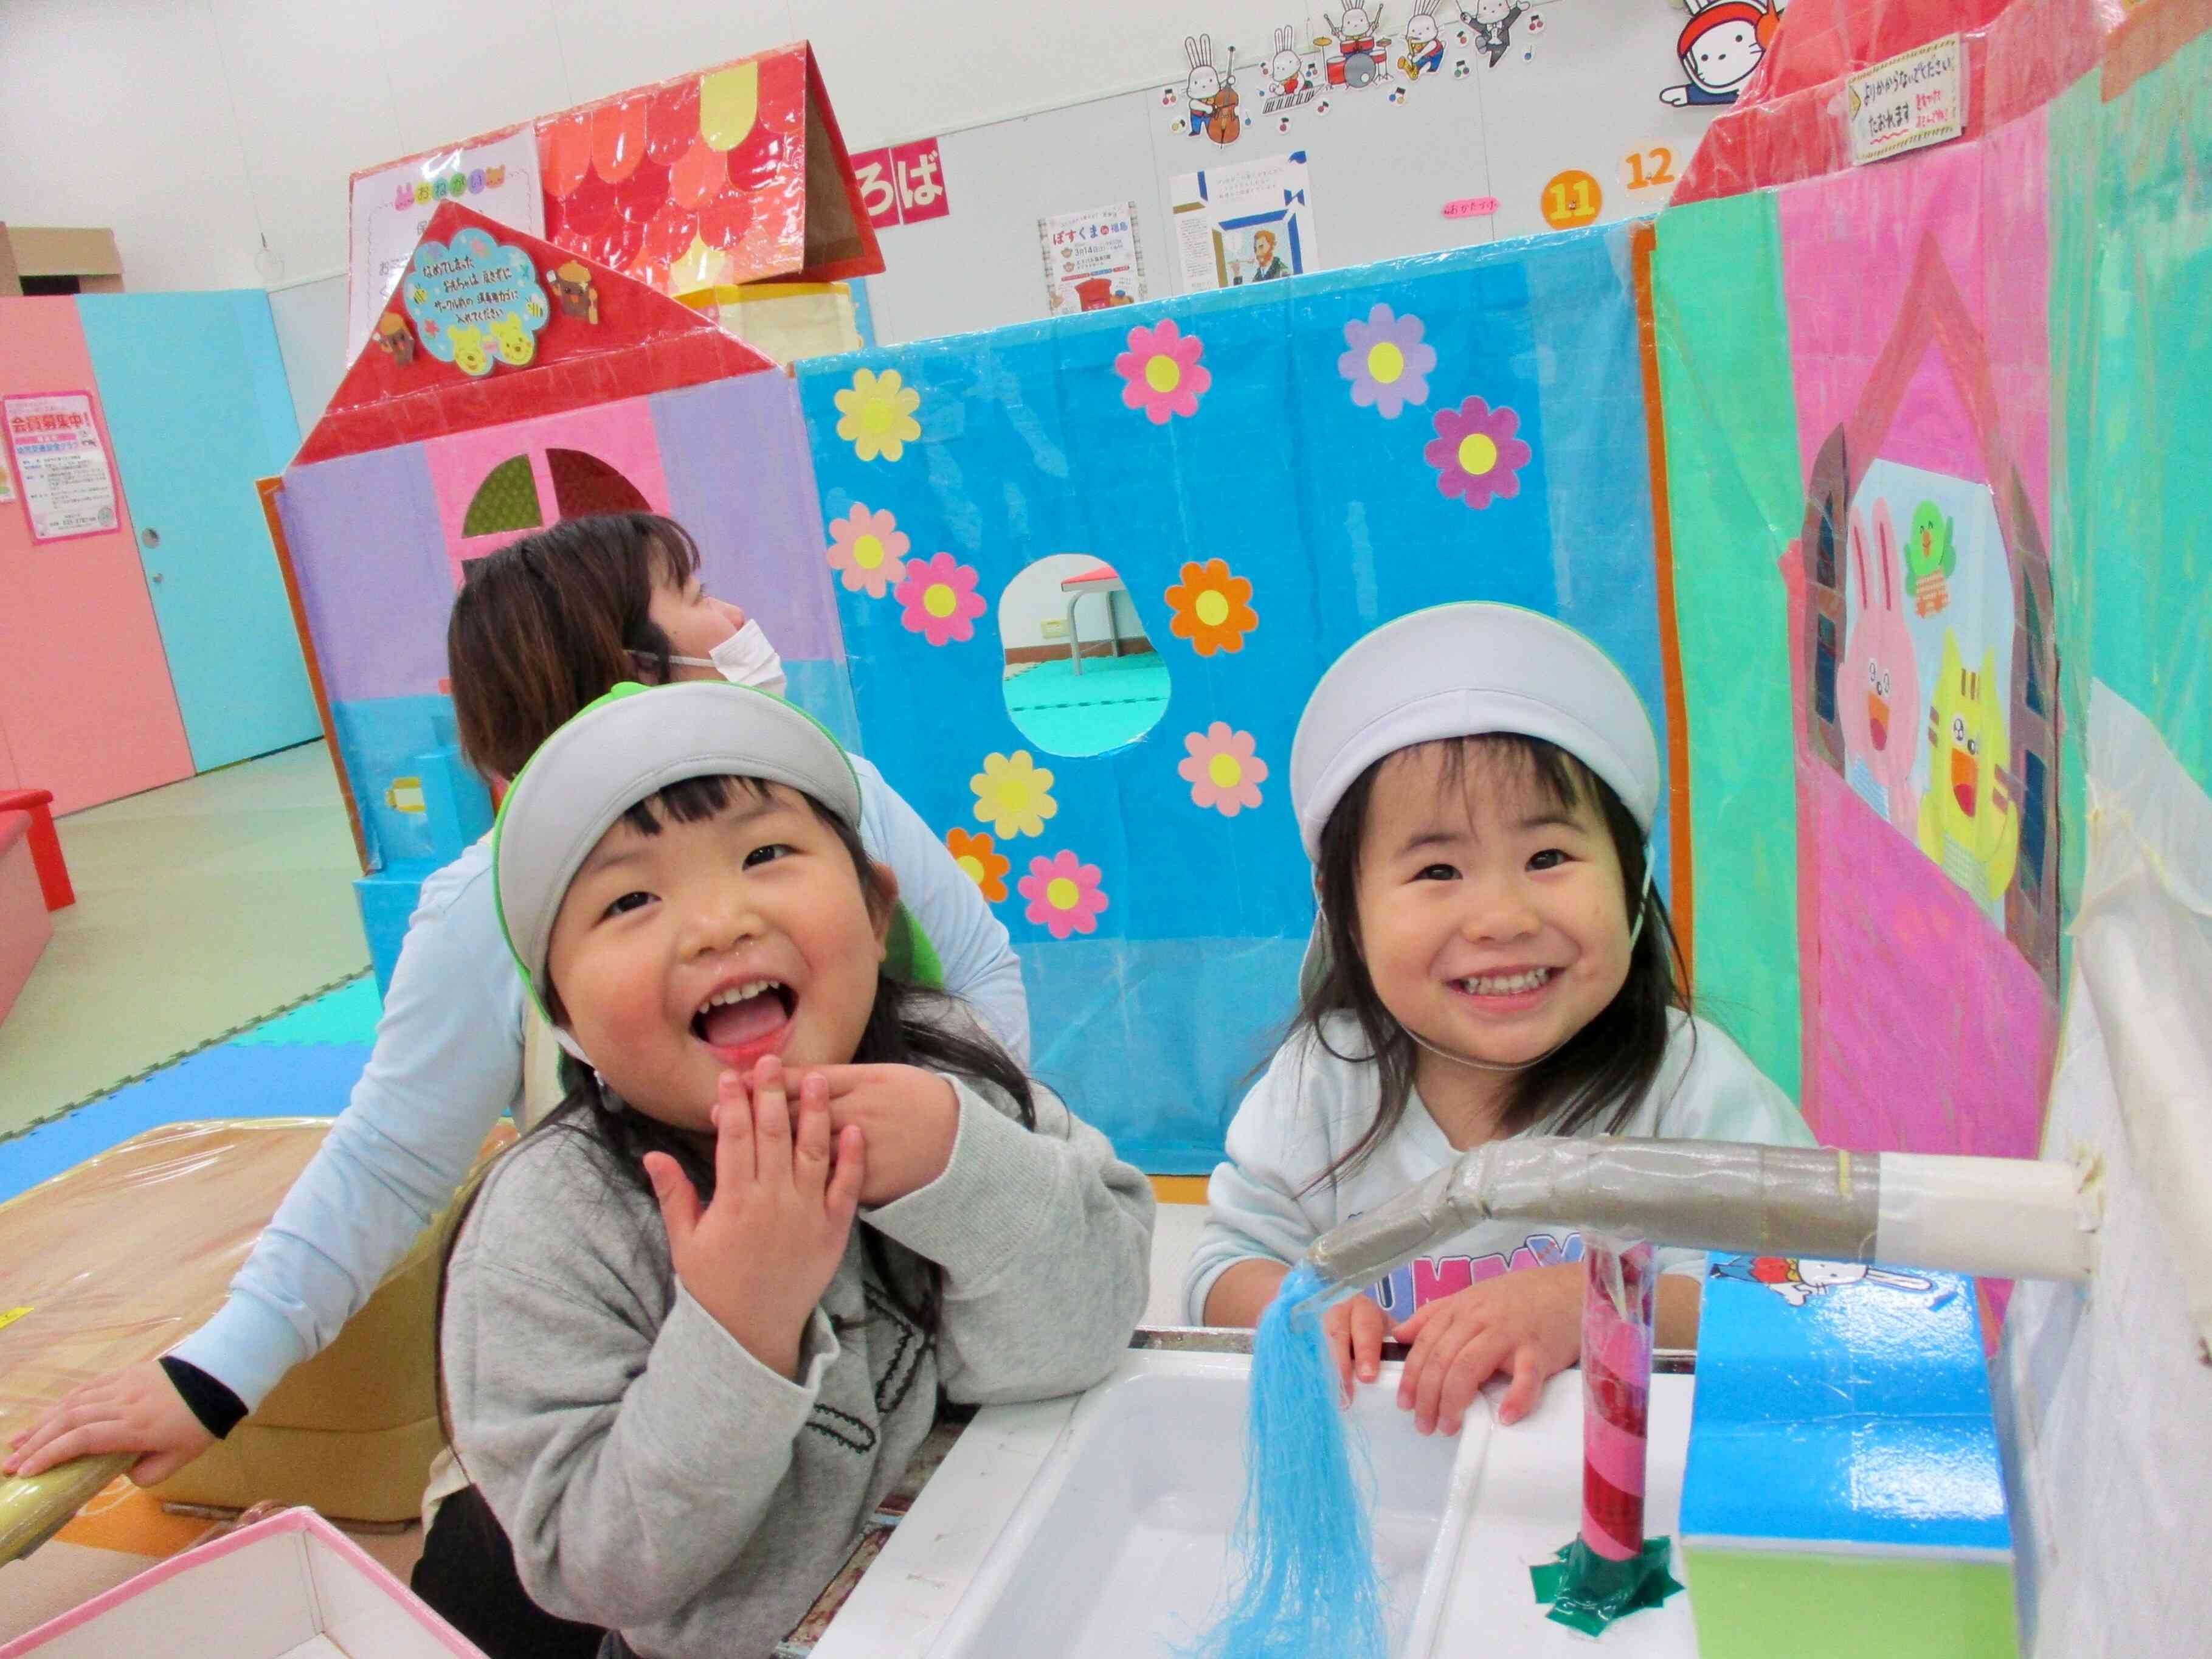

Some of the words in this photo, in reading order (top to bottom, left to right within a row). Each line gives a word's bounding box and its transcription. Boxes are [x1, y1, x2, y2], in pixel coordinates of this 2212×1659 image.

[418, 174, 483, 202] おねがい
[1626, 148, 1674, 189] 12
[1550, 180, 1595, 220] 11
